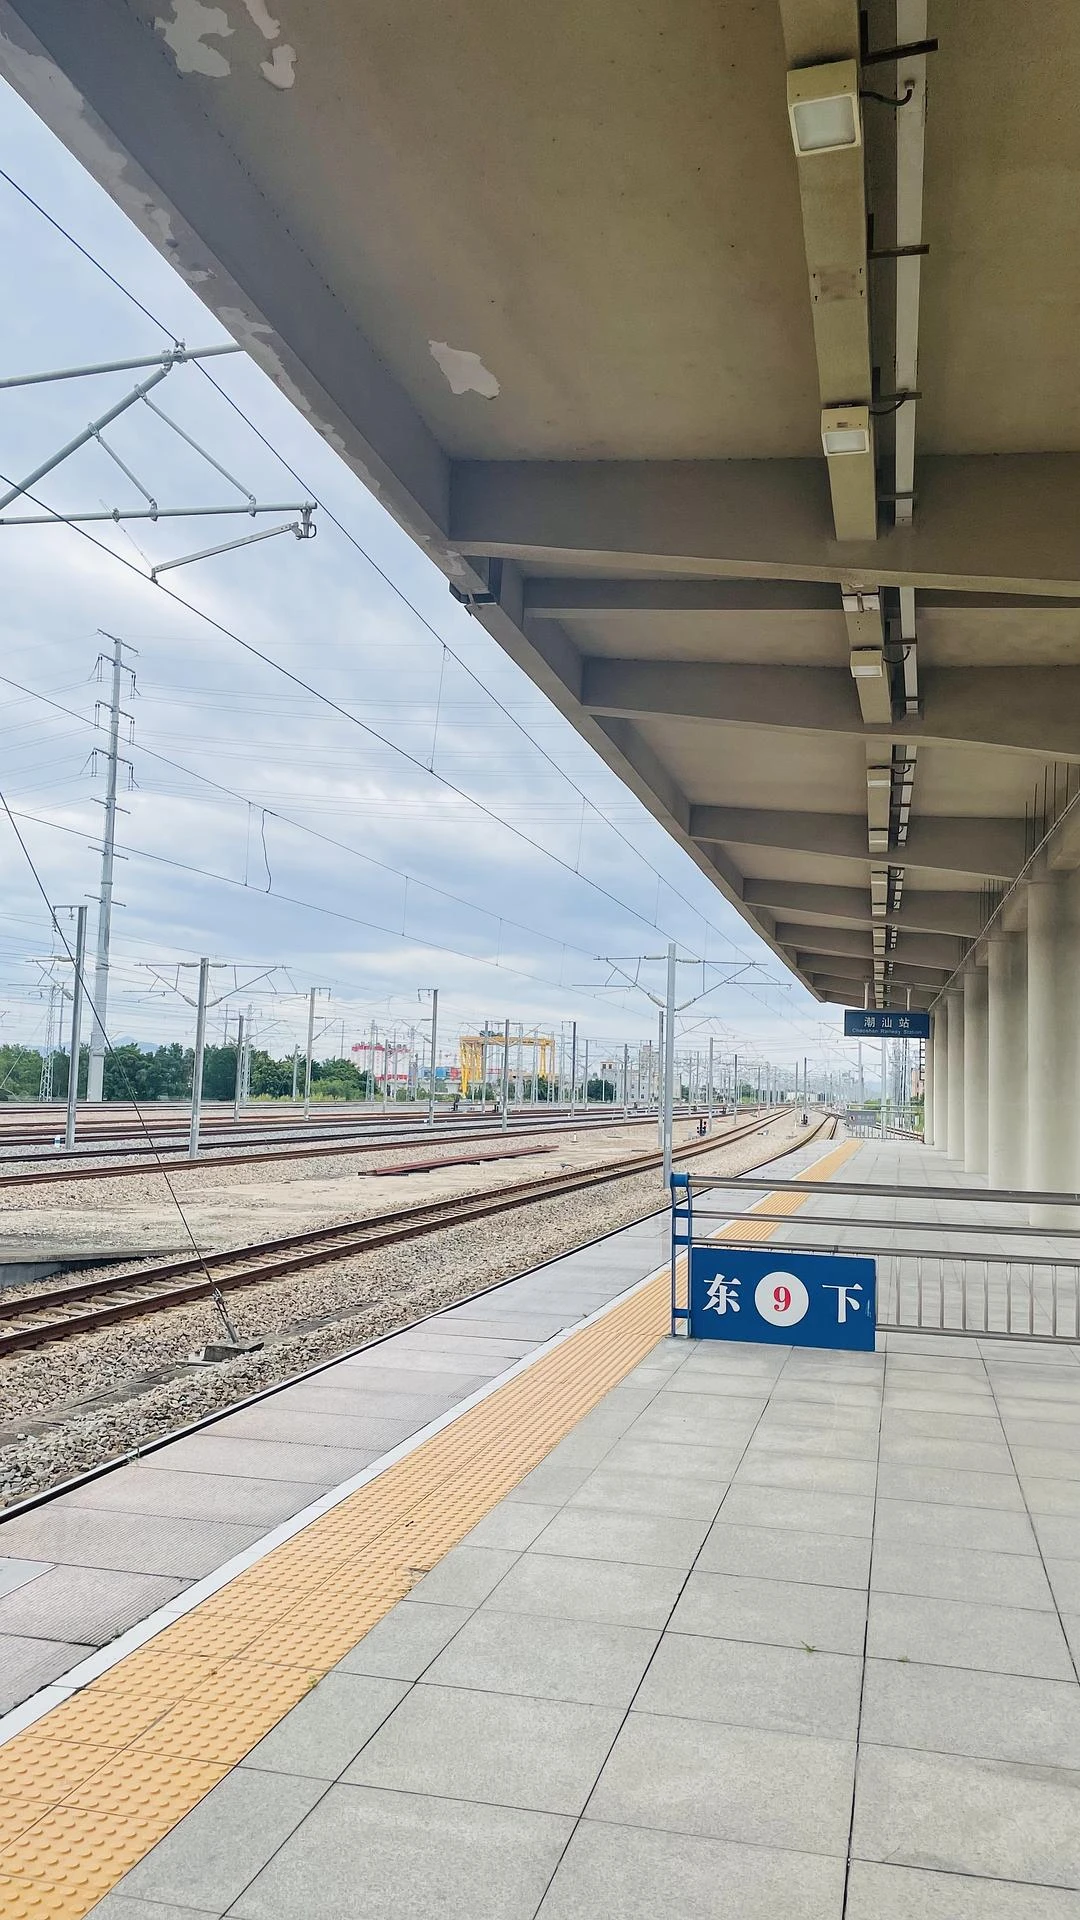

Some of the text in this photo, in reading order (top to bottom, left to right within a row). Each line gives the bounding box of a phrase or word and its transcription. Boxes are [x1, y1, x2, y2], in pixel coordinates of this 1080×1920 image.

[864, 1016, 910, 1028] 潮汕站
[702, 1273, 742, 1315] 东
[773, 1286, 792, 1312] 9
[821, 1283, 863, 1323] 下
